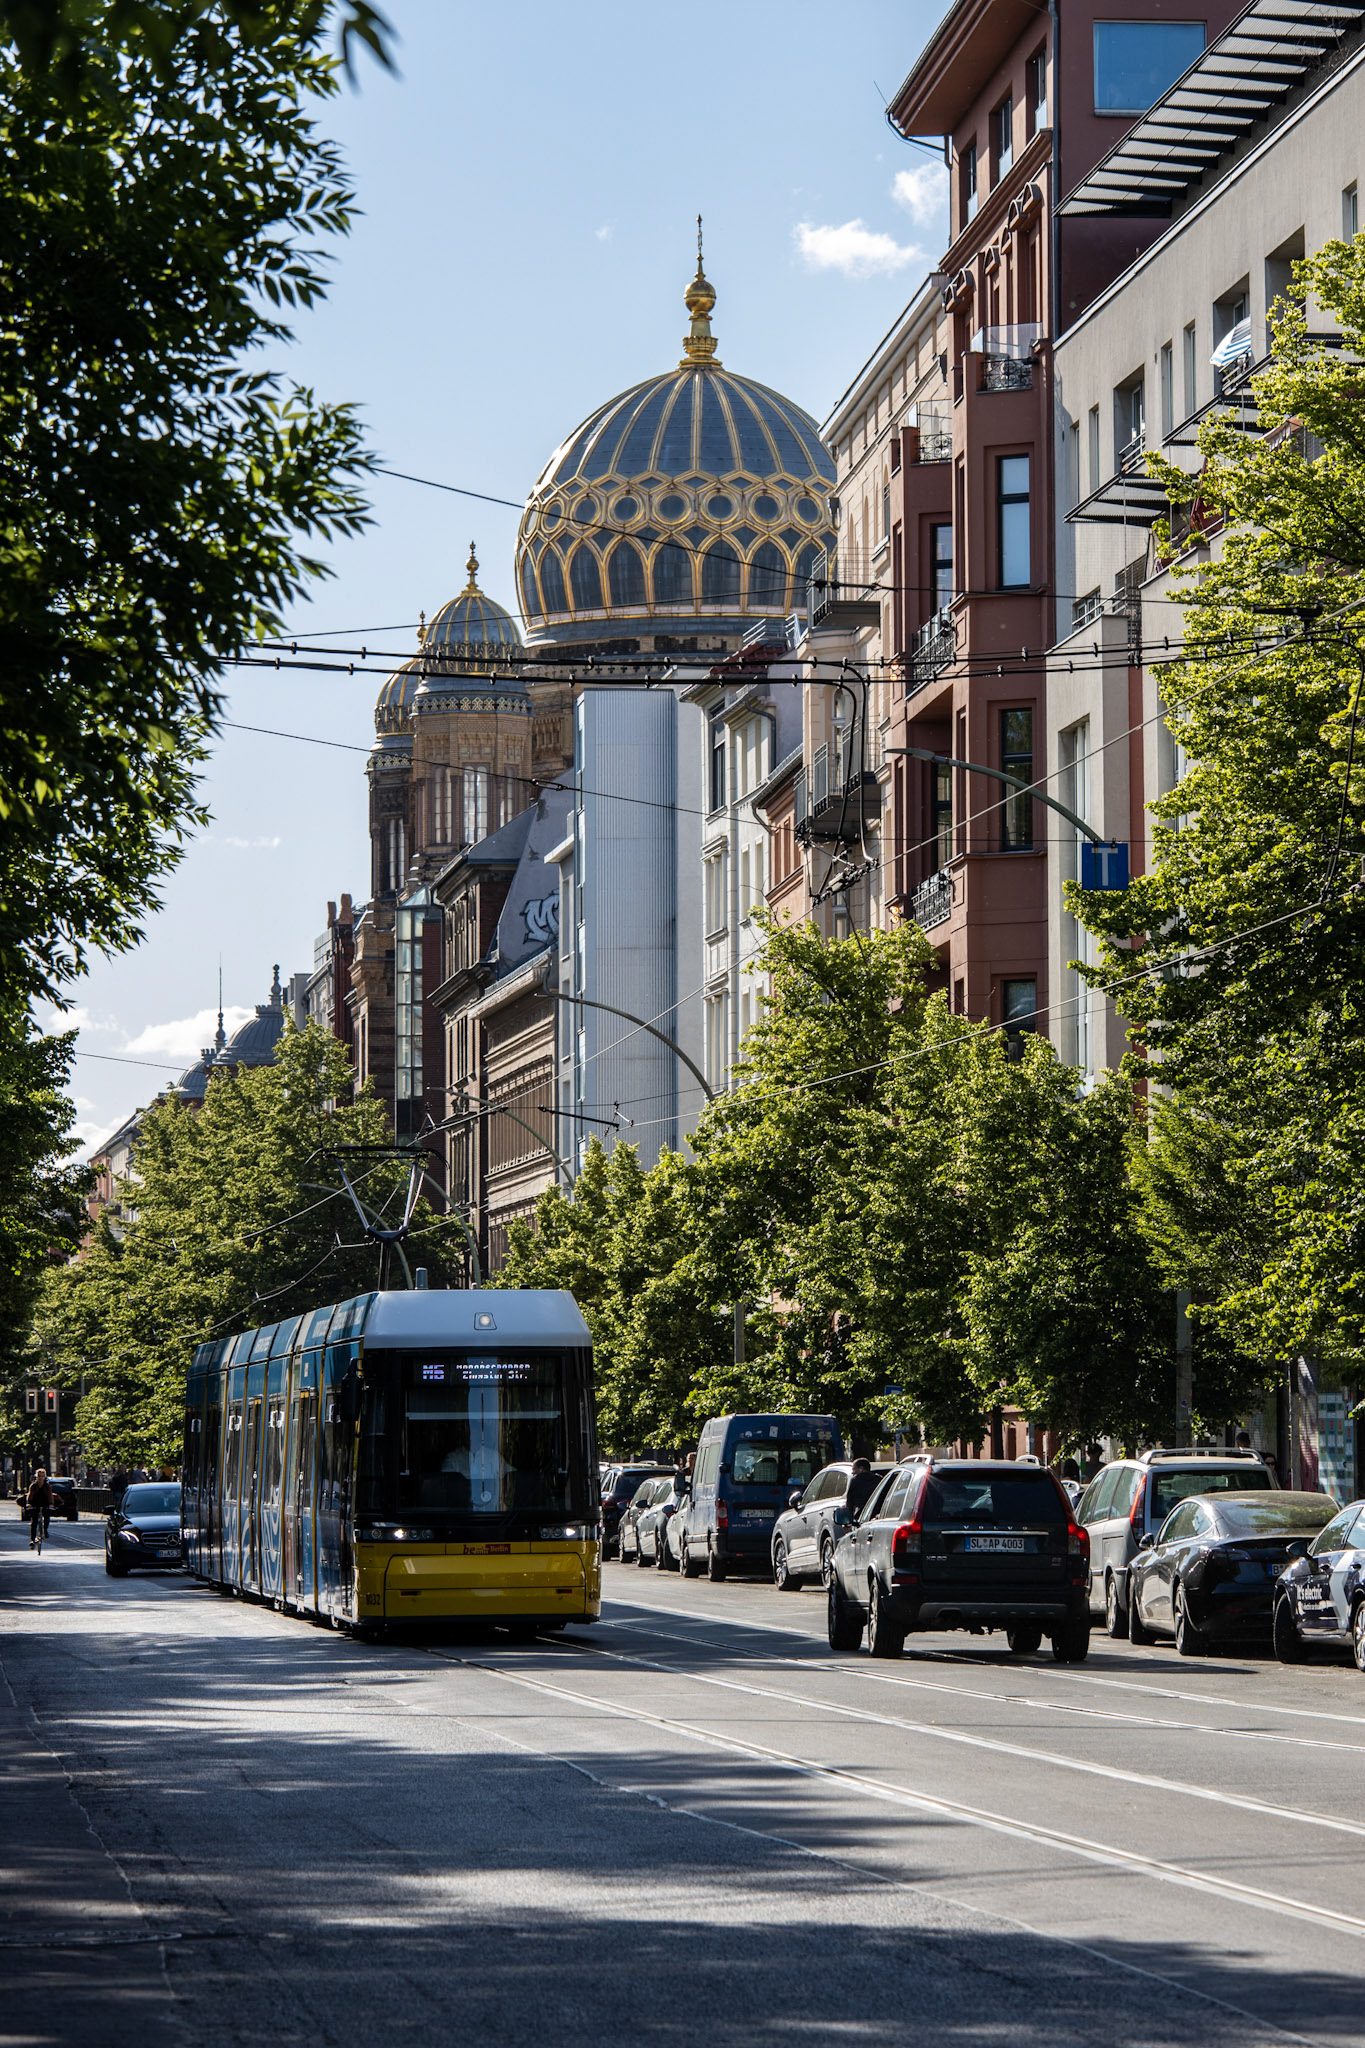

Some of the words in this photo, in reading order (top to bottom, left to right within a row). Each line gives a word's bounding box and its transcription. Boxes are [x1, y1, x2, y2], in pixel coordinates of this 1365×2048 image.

[1092, 847, 1118, 886] T
[971, 1538, 982, 1549] SL
[989, 1538, 1000, 1549] AP
[1002, 1538, 1023, 1549] 4003
